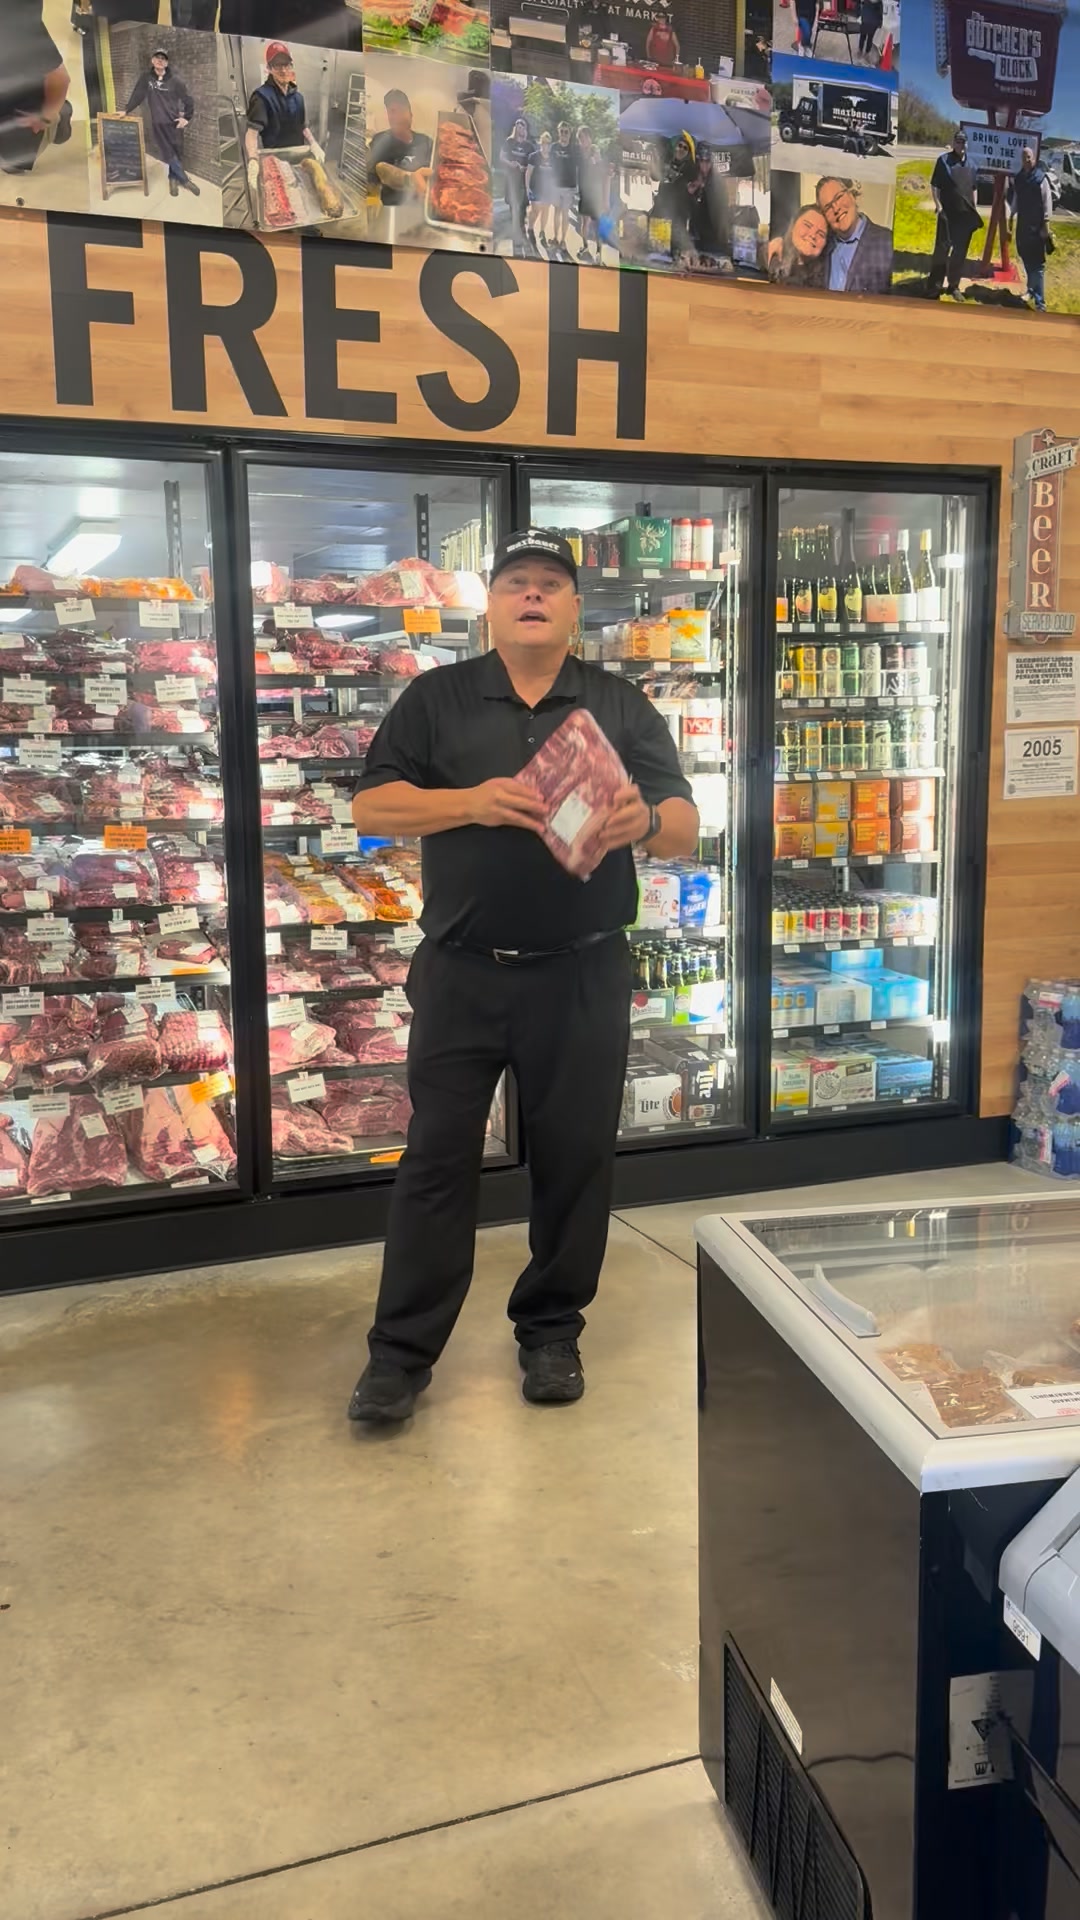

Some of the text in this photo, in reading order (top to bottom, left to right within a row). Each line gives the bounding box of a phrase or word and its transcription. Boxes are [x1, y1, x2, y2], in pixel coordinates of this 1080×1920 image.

[607, 5, 674, 24] AT MARKT
[999, 58, 1033, 79] BLOCK
[973, 132, 1028, 147] BRING LOVE
[983, 145, 1015, 158] TO THE
[986, 157, 1011, 169] TABLE
[47, 211, 646, 440] FRESH
[1022, 614, 1050, 631] SERVED
[1022, 739, 1062, 758] 2005
[639, 1098, 660, 1114] Lite
